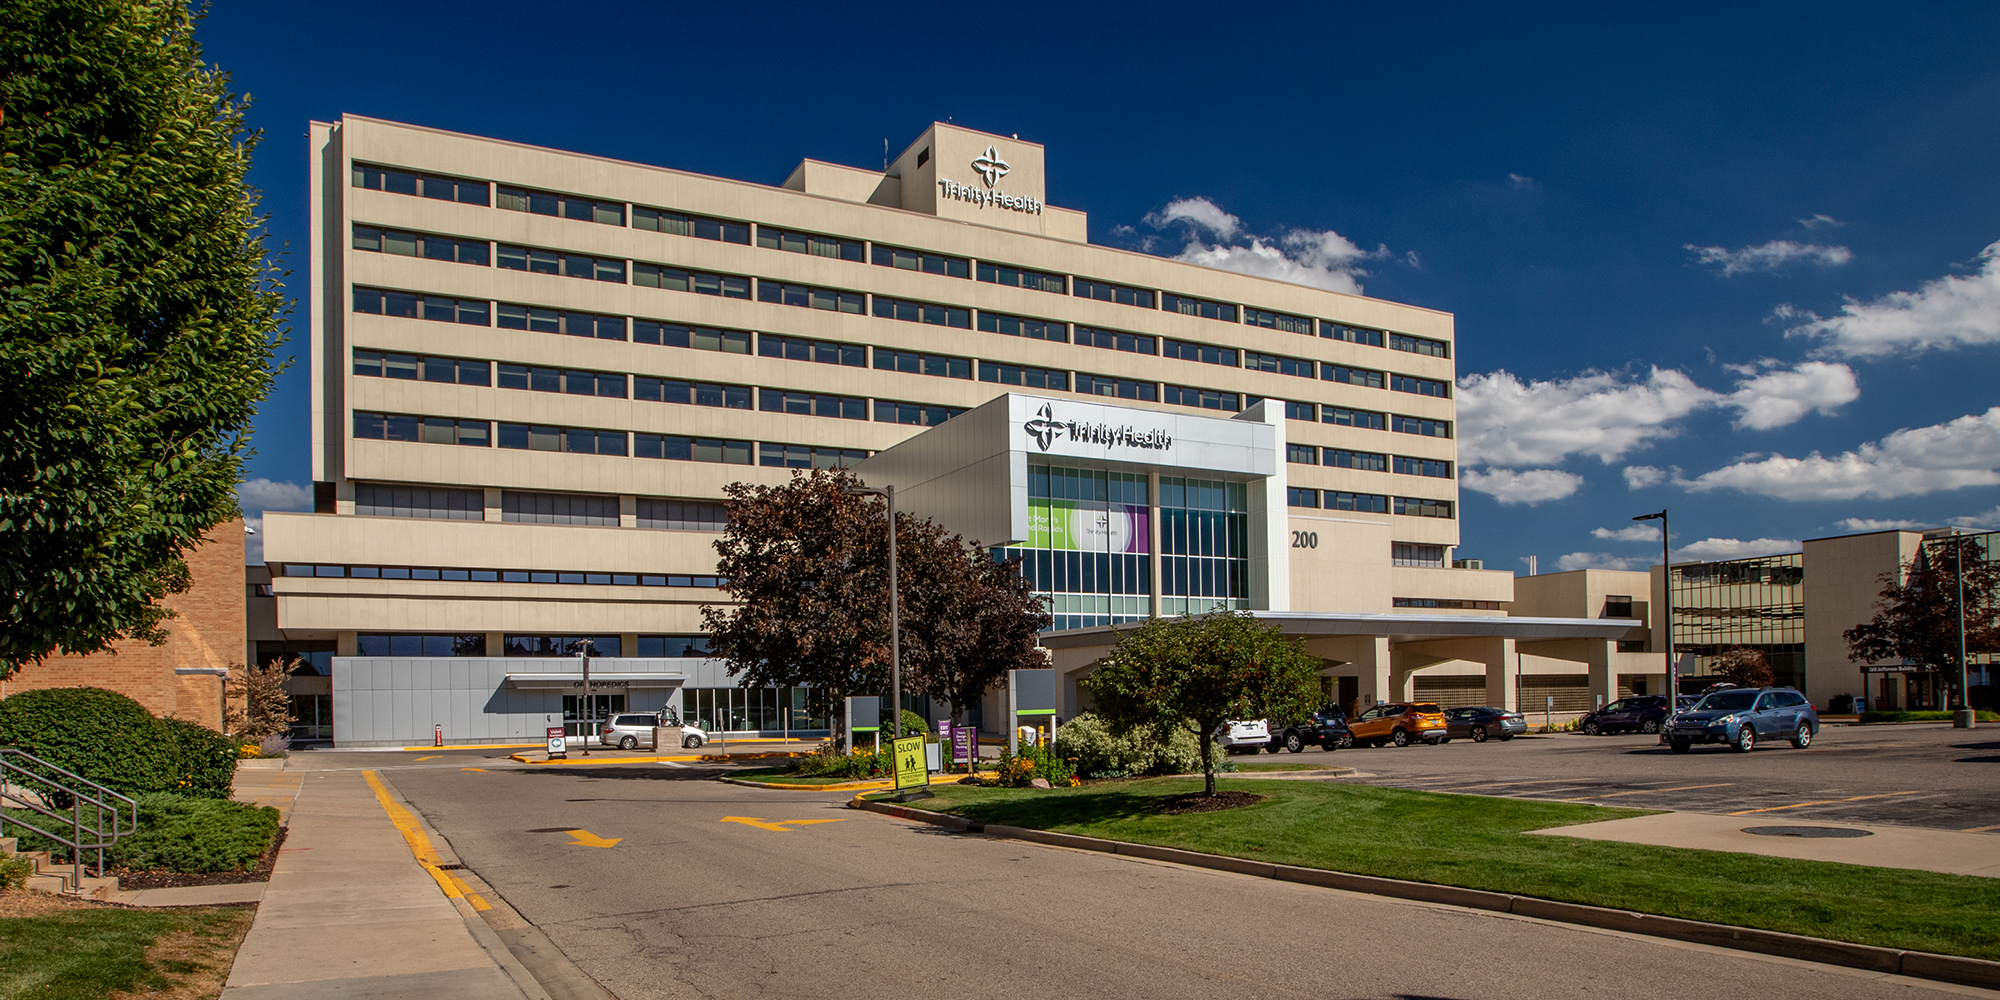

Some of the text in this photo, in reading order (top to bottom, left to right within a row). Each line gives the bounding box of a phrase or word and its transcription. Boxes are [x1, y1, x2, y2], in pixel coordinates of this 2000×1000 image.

[939, 178, 1043, 214] Trinity Health
[1067, 419, 1172, 450] Trinity Health
[1033, 515, 1059, 524] Mar's
[1086, 528, 1101, 536] Triity
[1292, 530, 1318, 549] 200
[897, 742, 920, 753] SLOW
